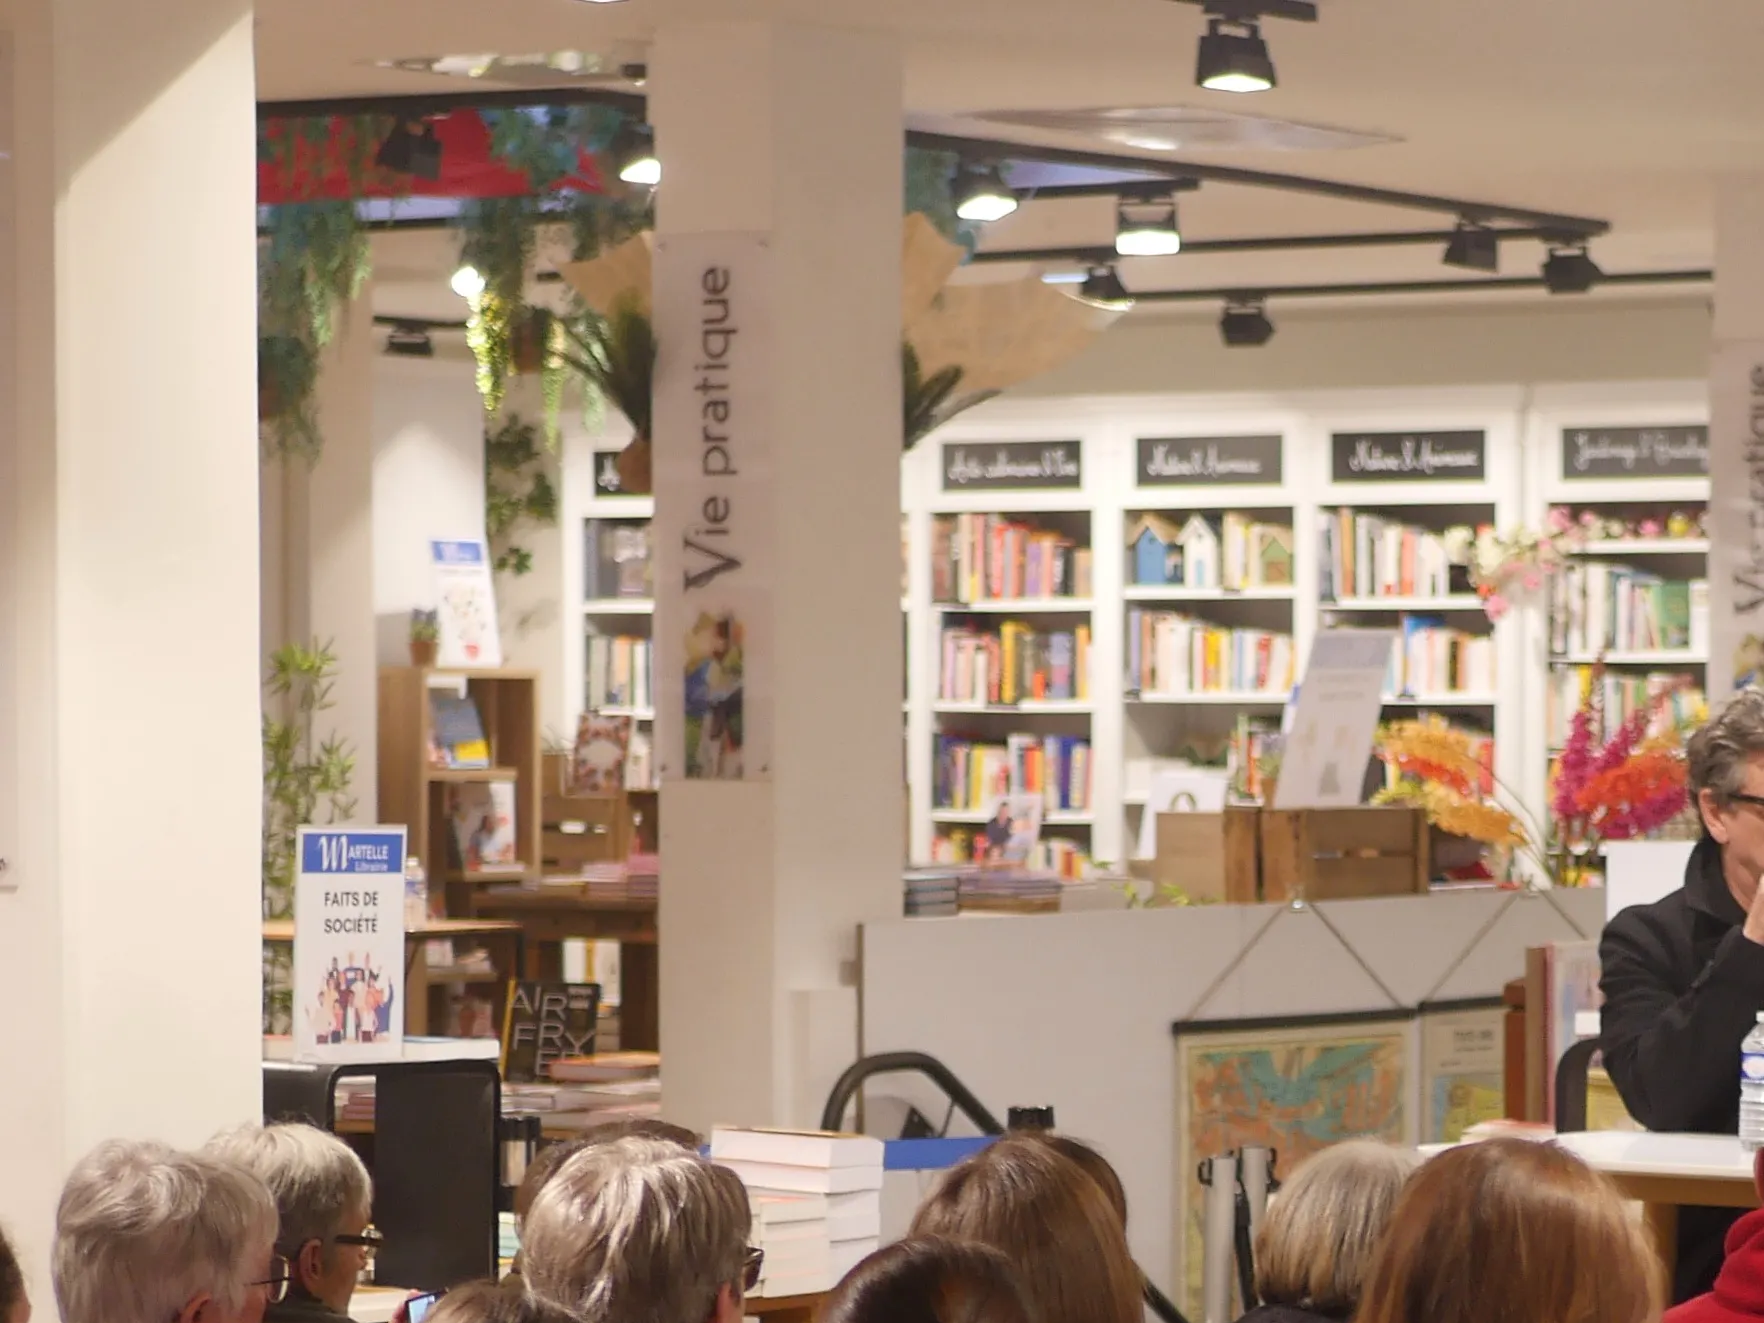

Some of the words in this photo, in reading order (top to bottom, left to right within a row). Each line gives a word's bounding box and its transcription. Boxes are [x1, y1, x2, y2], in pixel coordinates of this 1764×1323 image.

[694, 265, 739, 478] pratique
[684, 495, 742, 592] Vie
[323, 891, 359, 907] FAITS
[363, 891, 379, 907] DE
[323, 912, 378, 934] SOCIÉTÉ
[510, 985, 568, 1022] AIR
[513, 1022, 596, 1056] FRY
